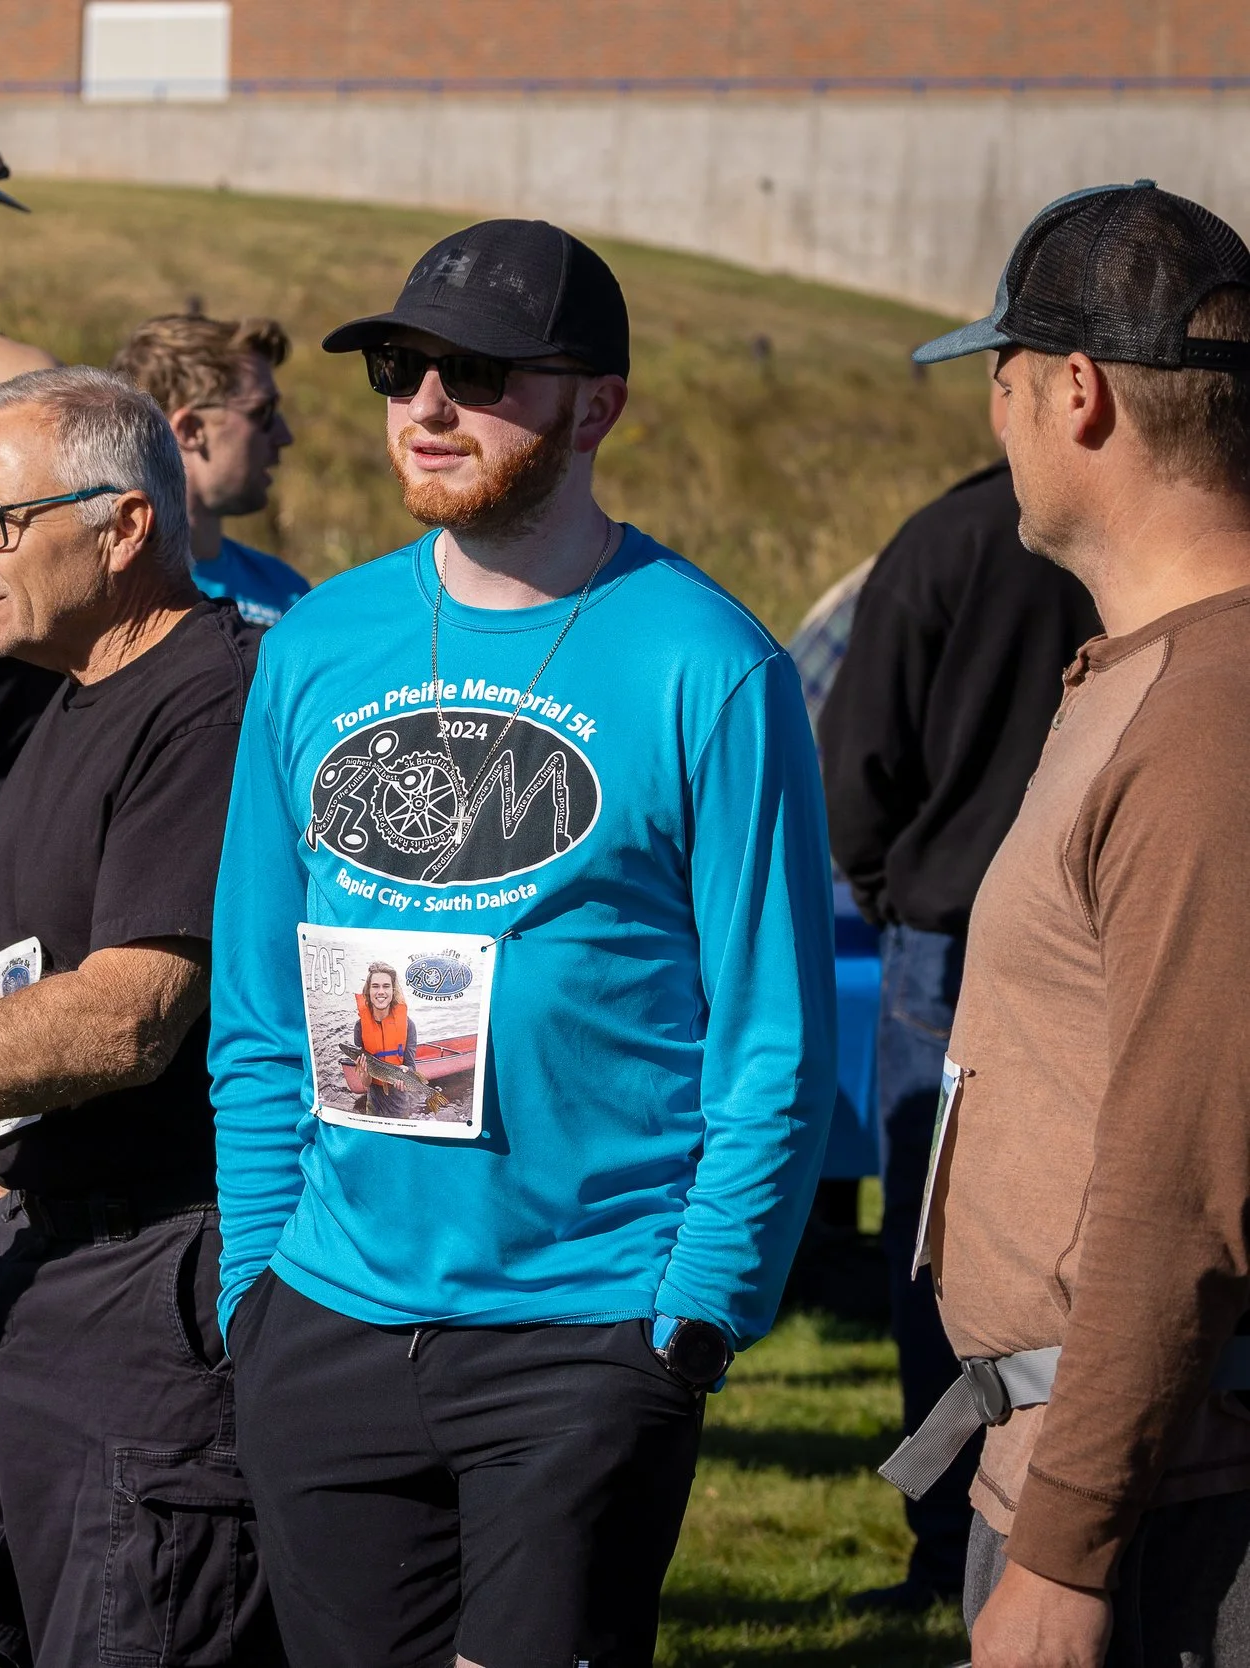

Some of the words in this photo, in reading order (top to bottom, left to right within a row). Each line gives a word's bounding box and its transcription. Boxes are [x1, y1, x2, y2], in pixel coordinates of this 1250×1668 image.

[332, 701, 379, 733] Tom
[385, 679, 457, 711] Pfeifle
[462, 678, 573, 723] Memorial
[566, 712, 597, 743] 5k
[437, 720, 488, 741] 2024
[337, 789, 349, 799] the
[345, 758, 372, 767] highest
[404, 760, 415, 768] 5k
[416, 758, 449, 771] Benefits
[490, 764, 503, 781] Hike
[471, 785, 489, 814] Recycle
[512, 799, 528, 821] Invite
[530, 778, 543, 794] new
[540, 756, 560, 779] friend
[556, 797, 565, 834] postcard
[411, 833, 446, 848] Benefits
[432, 847, 456, 872] Reduce
[336, 867, 377, 900] Rapid
[378, 887, 412, 912] City
[424, 896, 472, 912] South
[476, 883, 538, 910] Dakota
[305, 943, 347, 997] 795
[412, 989, 434, 1001] RAPID
